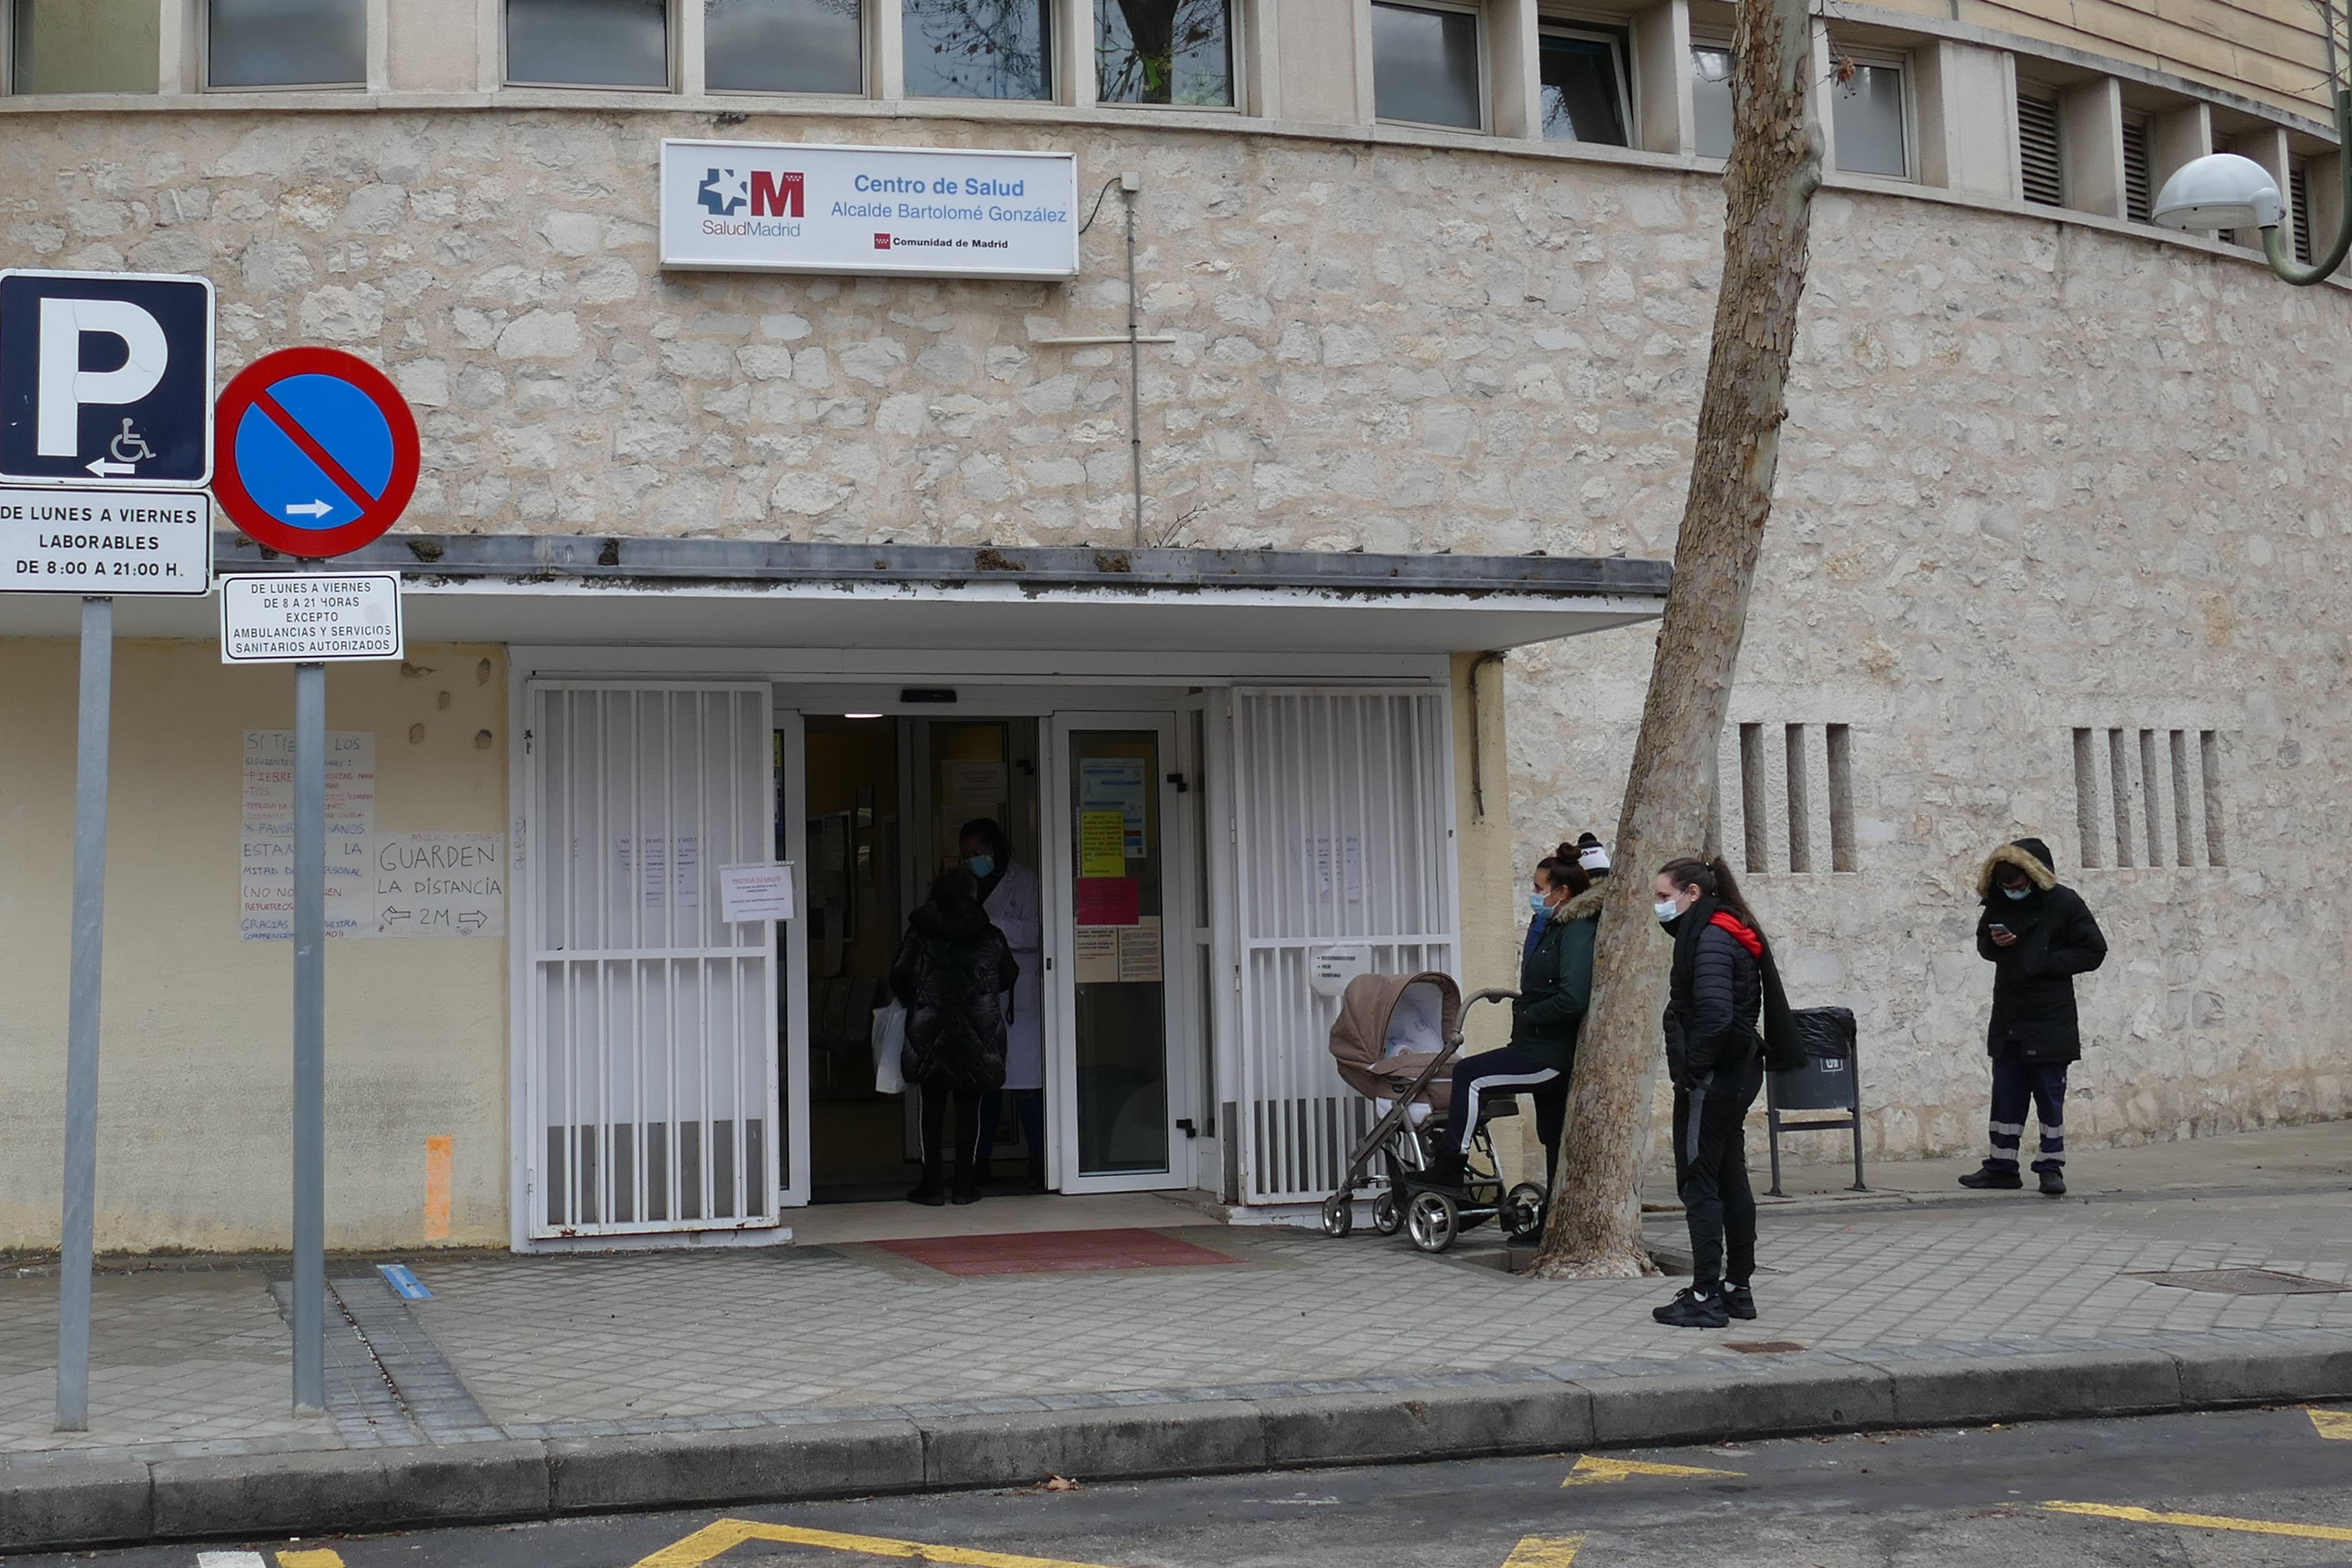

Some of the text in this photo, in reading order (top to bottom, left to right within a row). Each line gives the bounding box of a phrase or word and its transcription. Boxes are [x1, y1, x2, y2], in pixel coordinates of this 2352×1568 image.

[854, 174, 1024, 197] Centro de Salud
[831, 201, 1066, 223] Alcalde Bartolomé González
[702, 220, 800, 237] SaludMadrid
[893, 237, 1008, 249] Comunidad de Madrid
[38, 297, 168, 456] P
[0, 506, 197, 524] DE LUNES A VIERNES
[40, 535, 159, 549] LABORABLES
[16, 560, 39, 573] DE
[95, 562, 106, 575] A
[113, 563, 159, 576] 21:00
[166, 563, 184, 577] H.
[251, 582, 371, 594] DE LUNES A VIERNES
[264, 598, 278, 608] DE
[283, 598, 288, 608] 8
[293, 598, 300, 607] A
[304, 598, 316, 607] 21
[286, 612, 339, 622] EXCEPTO
[233, 625, 391, 638] AMBULANCIAS Y SERVICIOS
[236, 640, 389, 653] SANITARIOS AUTORIZADOS
[248, 733, 360, 752] SI TIE LOS
[344, 843, 362, 855] LA
[380, 843, 494, 871] GUARDEN
[242, 866, 278, 875] MITAD
[378, 879, 402, 894] LA
[242, 919, 288, 931] GRACIAS
